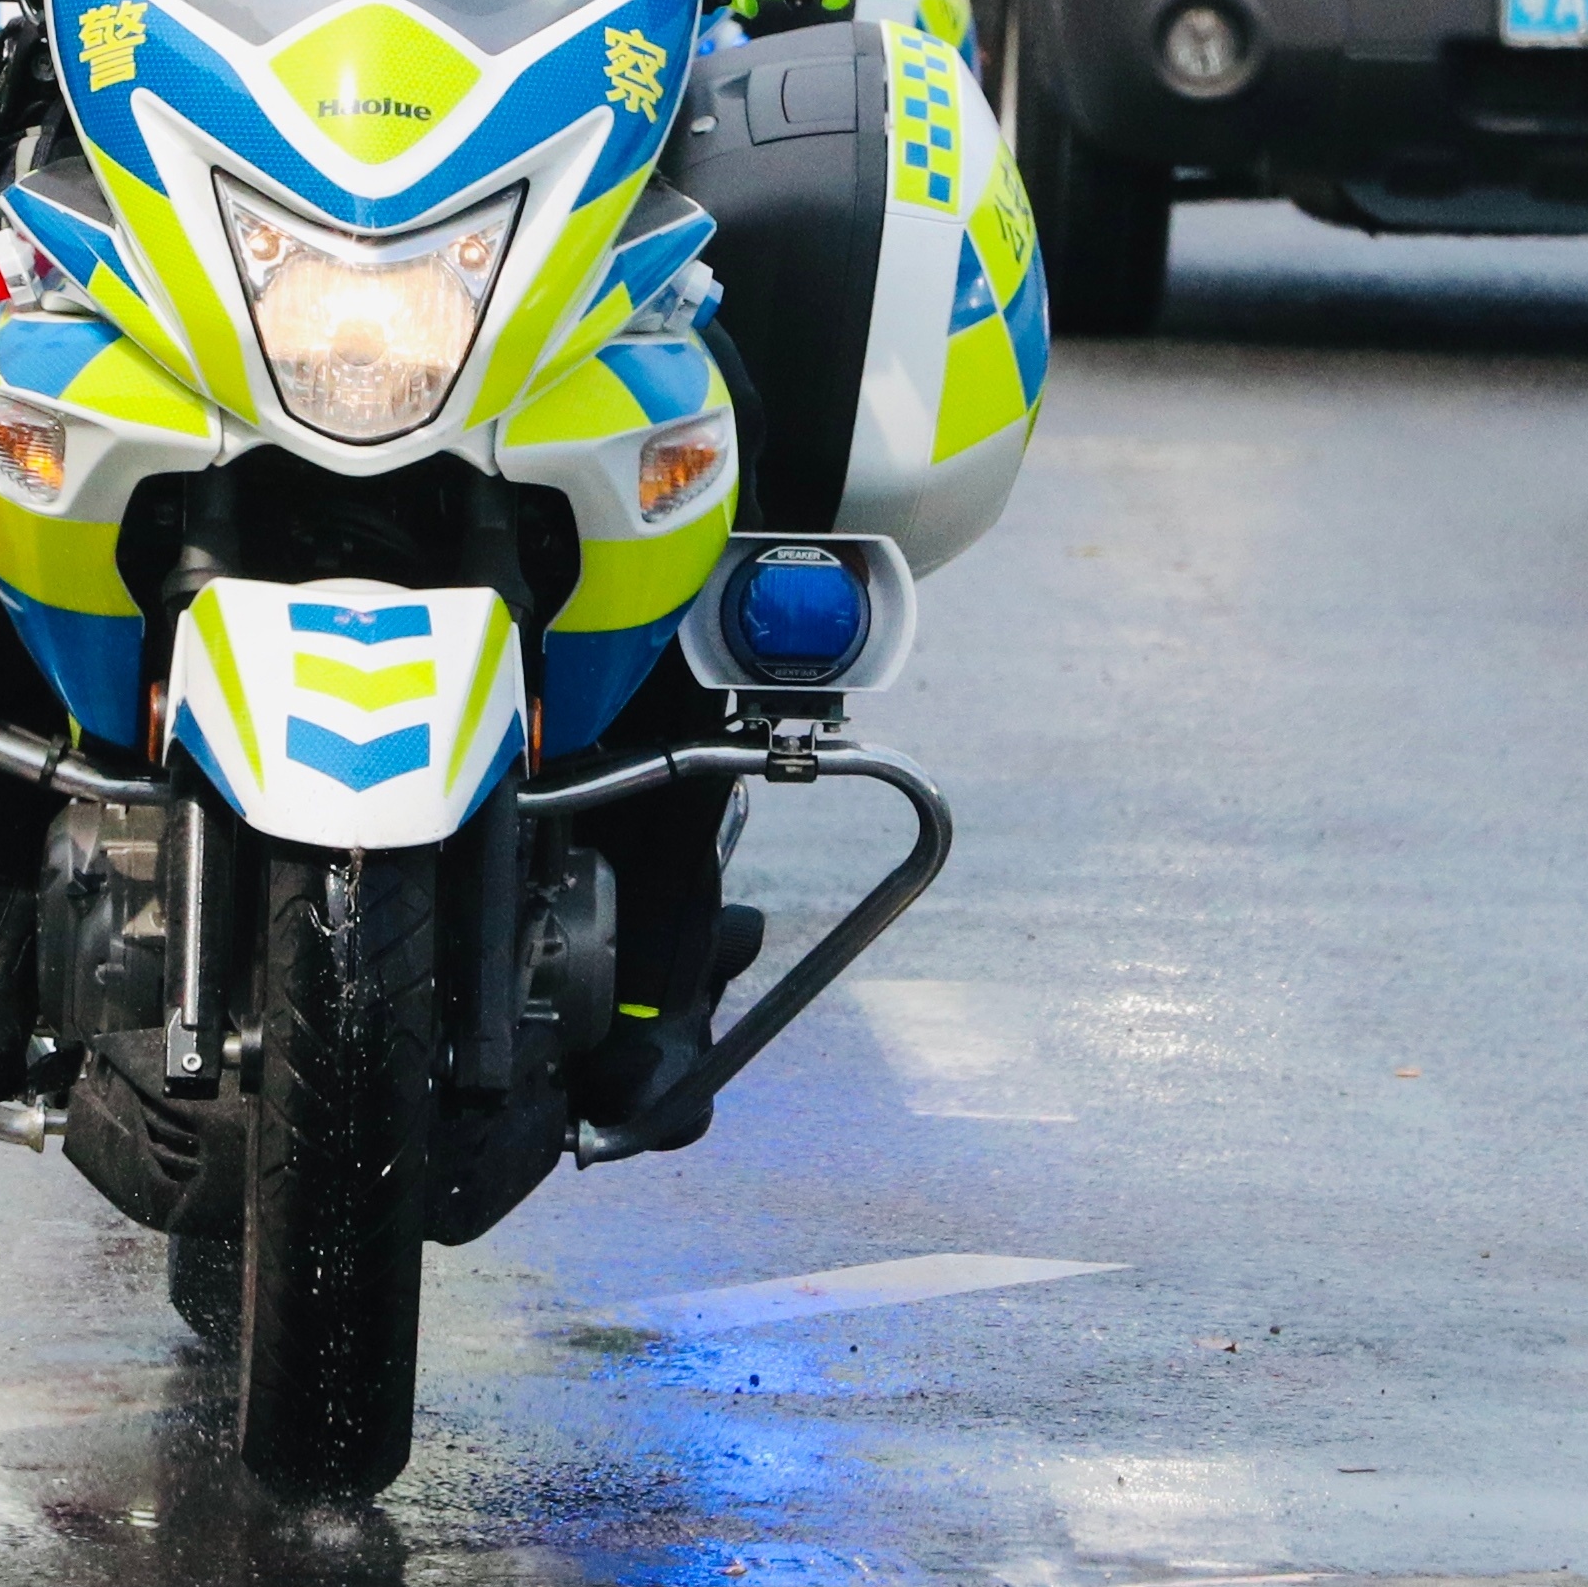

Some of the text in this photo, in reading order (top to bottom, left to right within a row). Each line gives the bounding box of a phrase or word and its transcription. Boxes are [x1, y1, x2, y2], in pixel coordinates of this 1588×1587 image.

[78, 0, 667, 124] 警 察
[317, 97, 432, 121] Haojue
[777, 550, 822, 560] SPEAKER
